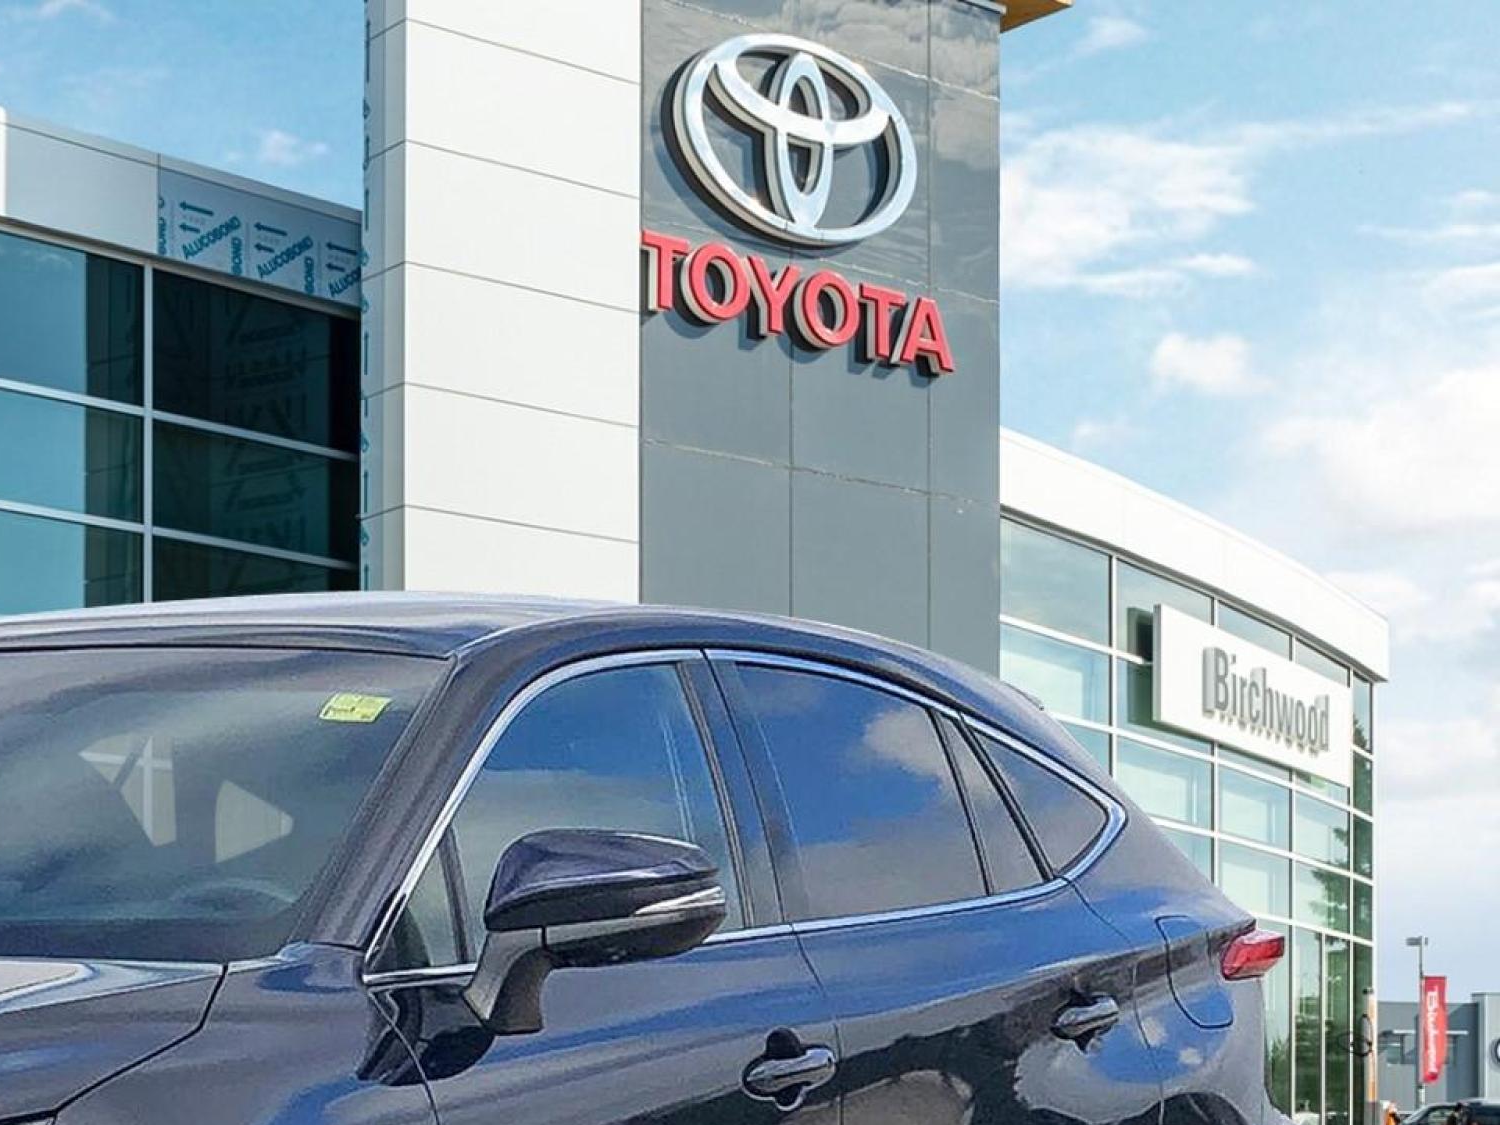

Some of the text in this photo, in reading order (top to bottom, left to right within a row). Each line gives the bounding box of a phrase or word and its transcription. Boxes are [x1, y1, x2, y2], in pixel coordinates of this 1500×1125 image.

[182, 215, 241, 261] ALUCOBOND
[257, 235, 314, 280] ALUCOBOND
[641, 230, 955, 375] TOYOTA
[1209, 646, 1330, 754] Birchwood
